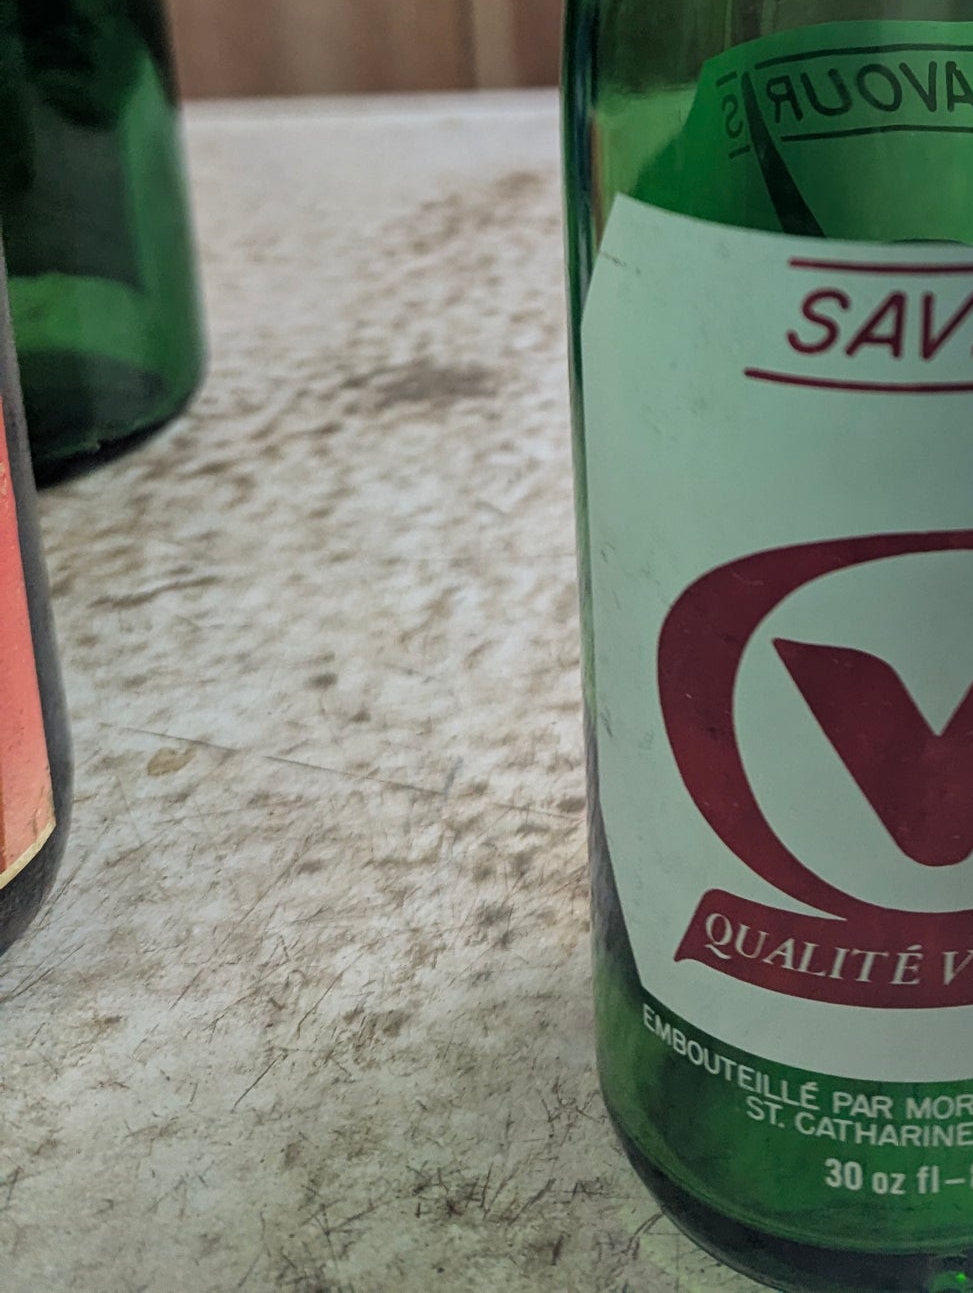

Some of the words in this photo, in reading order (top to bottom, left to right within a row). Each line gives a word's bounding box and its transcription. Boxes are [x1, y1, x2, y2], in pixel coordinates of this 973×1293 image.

[704, 911, 924, 986] QUALITÉ
[642, 1002, 821, 1111] EMBOUTEILLÉ
[832, 1090, 894, 1120] PAR
[745, 1095, 786, 1129] ST.
[824, 1158, 863, 1191] 30
[871, 1172, 906, 1195] oz
